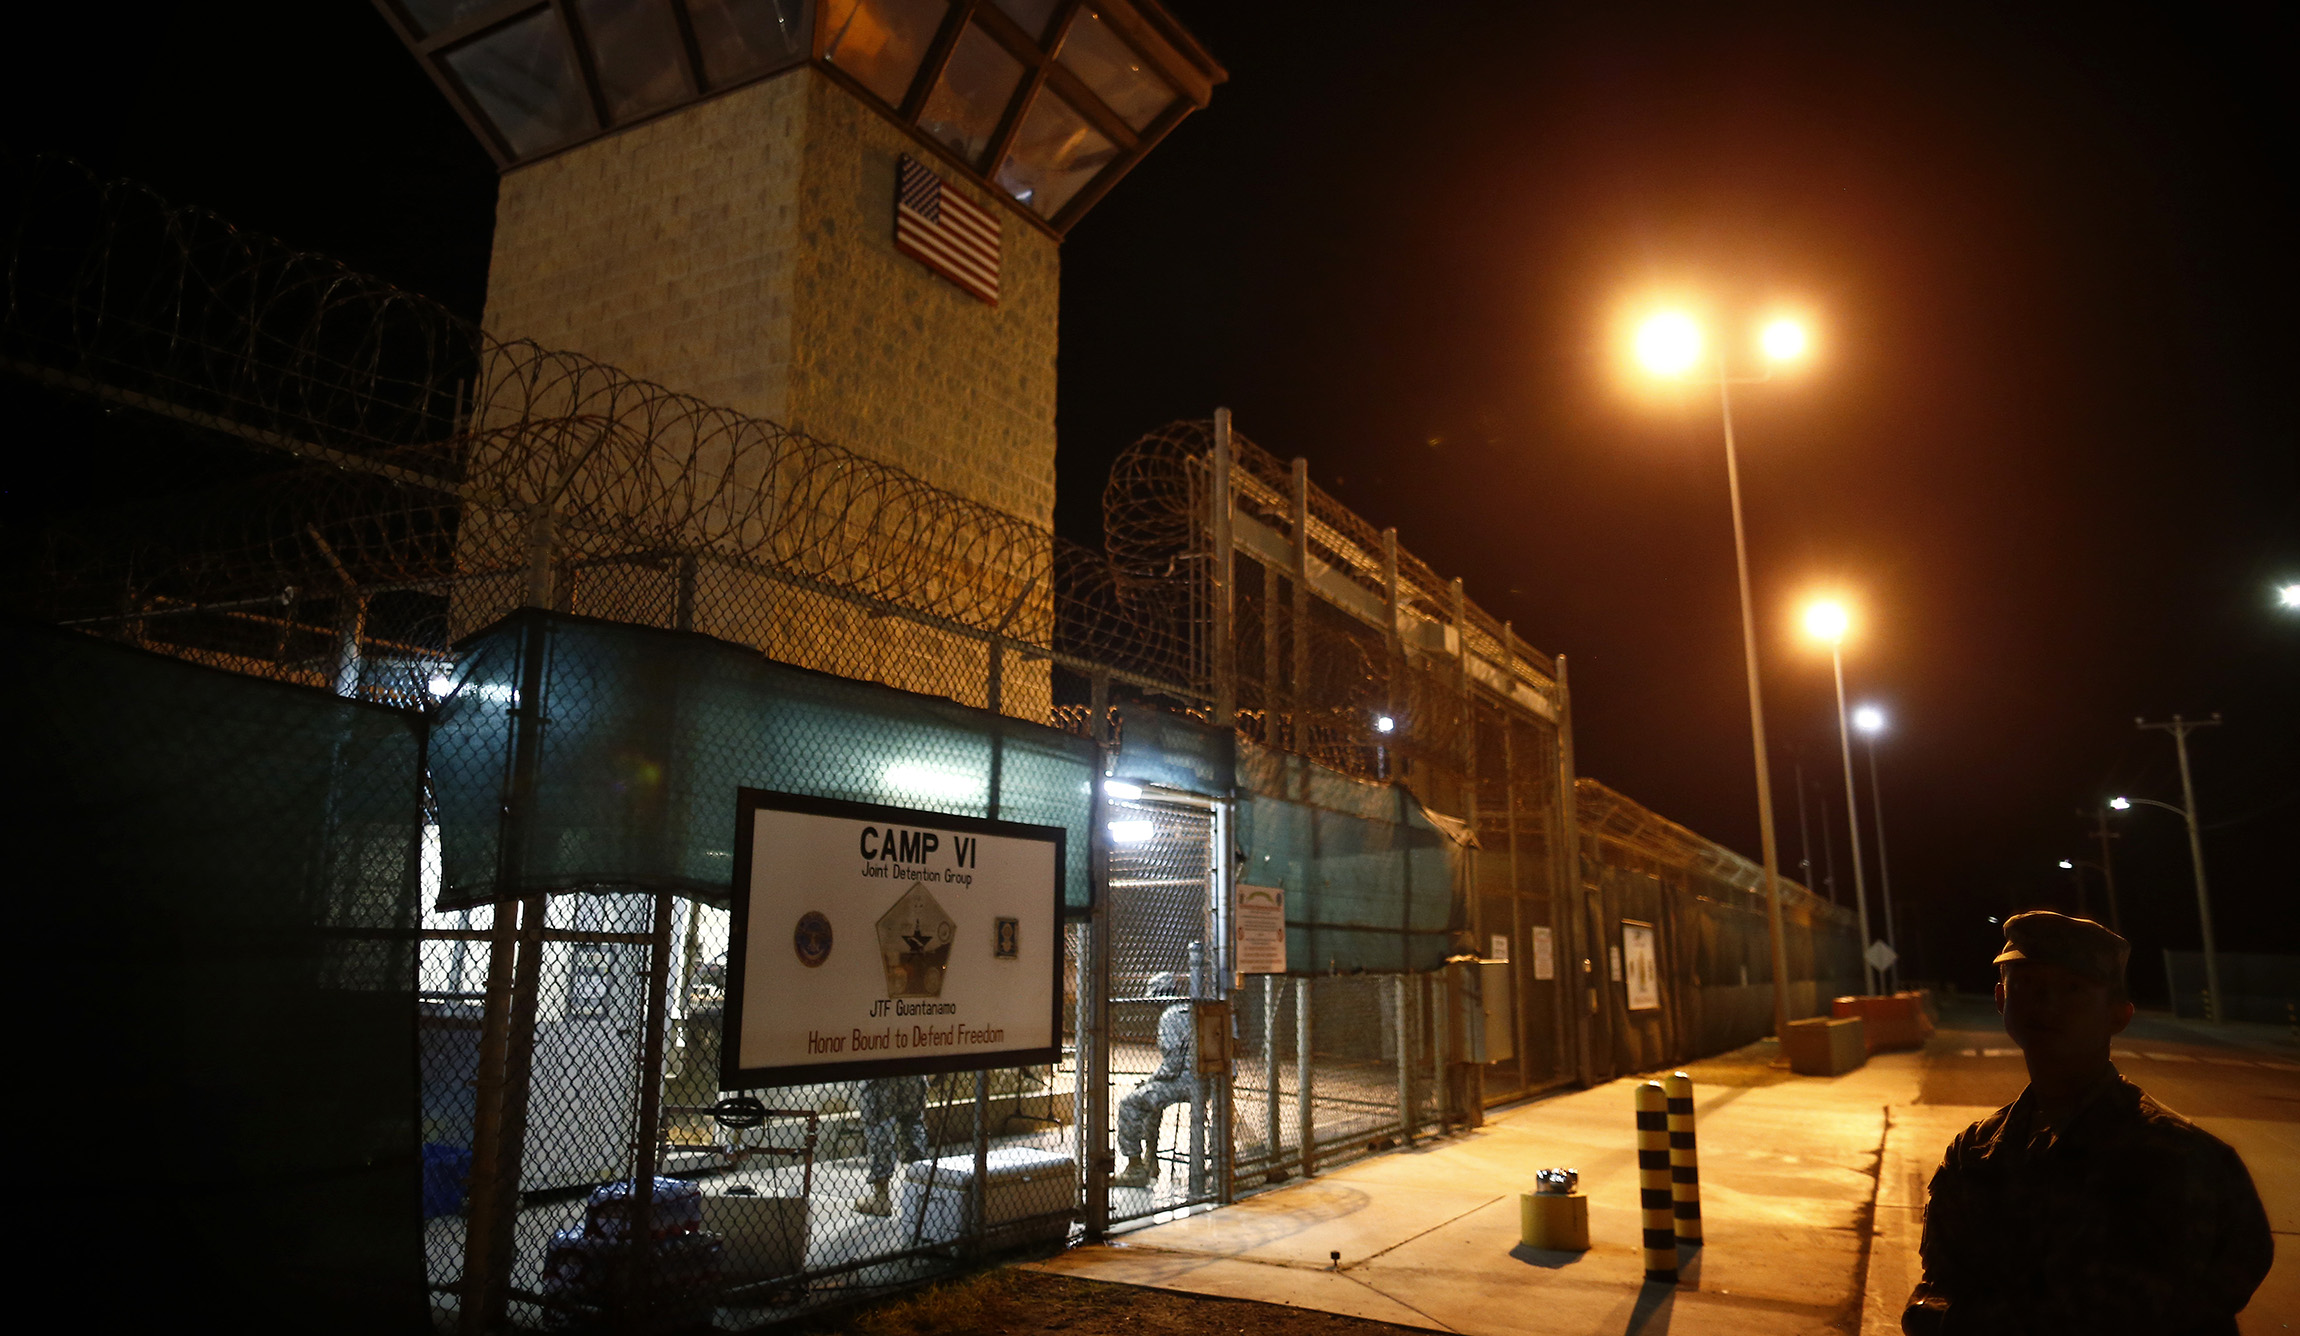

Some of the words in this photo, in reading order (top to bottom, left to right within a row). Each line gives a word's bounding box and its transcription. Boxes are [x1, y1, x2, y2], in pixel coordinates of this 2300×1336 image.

[860, 826, 939, 865] CAMP
[954, 836, 976, 869] VI
[861, 863, 888, 878] Joint
[893, 864, 941, 882] Detention
[944, 868, 972, 889] Group
[870, 1000, 891, 1017] JTF
[896, 999, 956, 1017] Guantanamo
[808, 1029, 846, 1055] Honor
[852, 1026, 890, 1051] Bound
[895, 1029, 908, 1048] to
[912, 1025, 954, 1047] Defend
[958, 1023, 1004, 1045] Freedom
